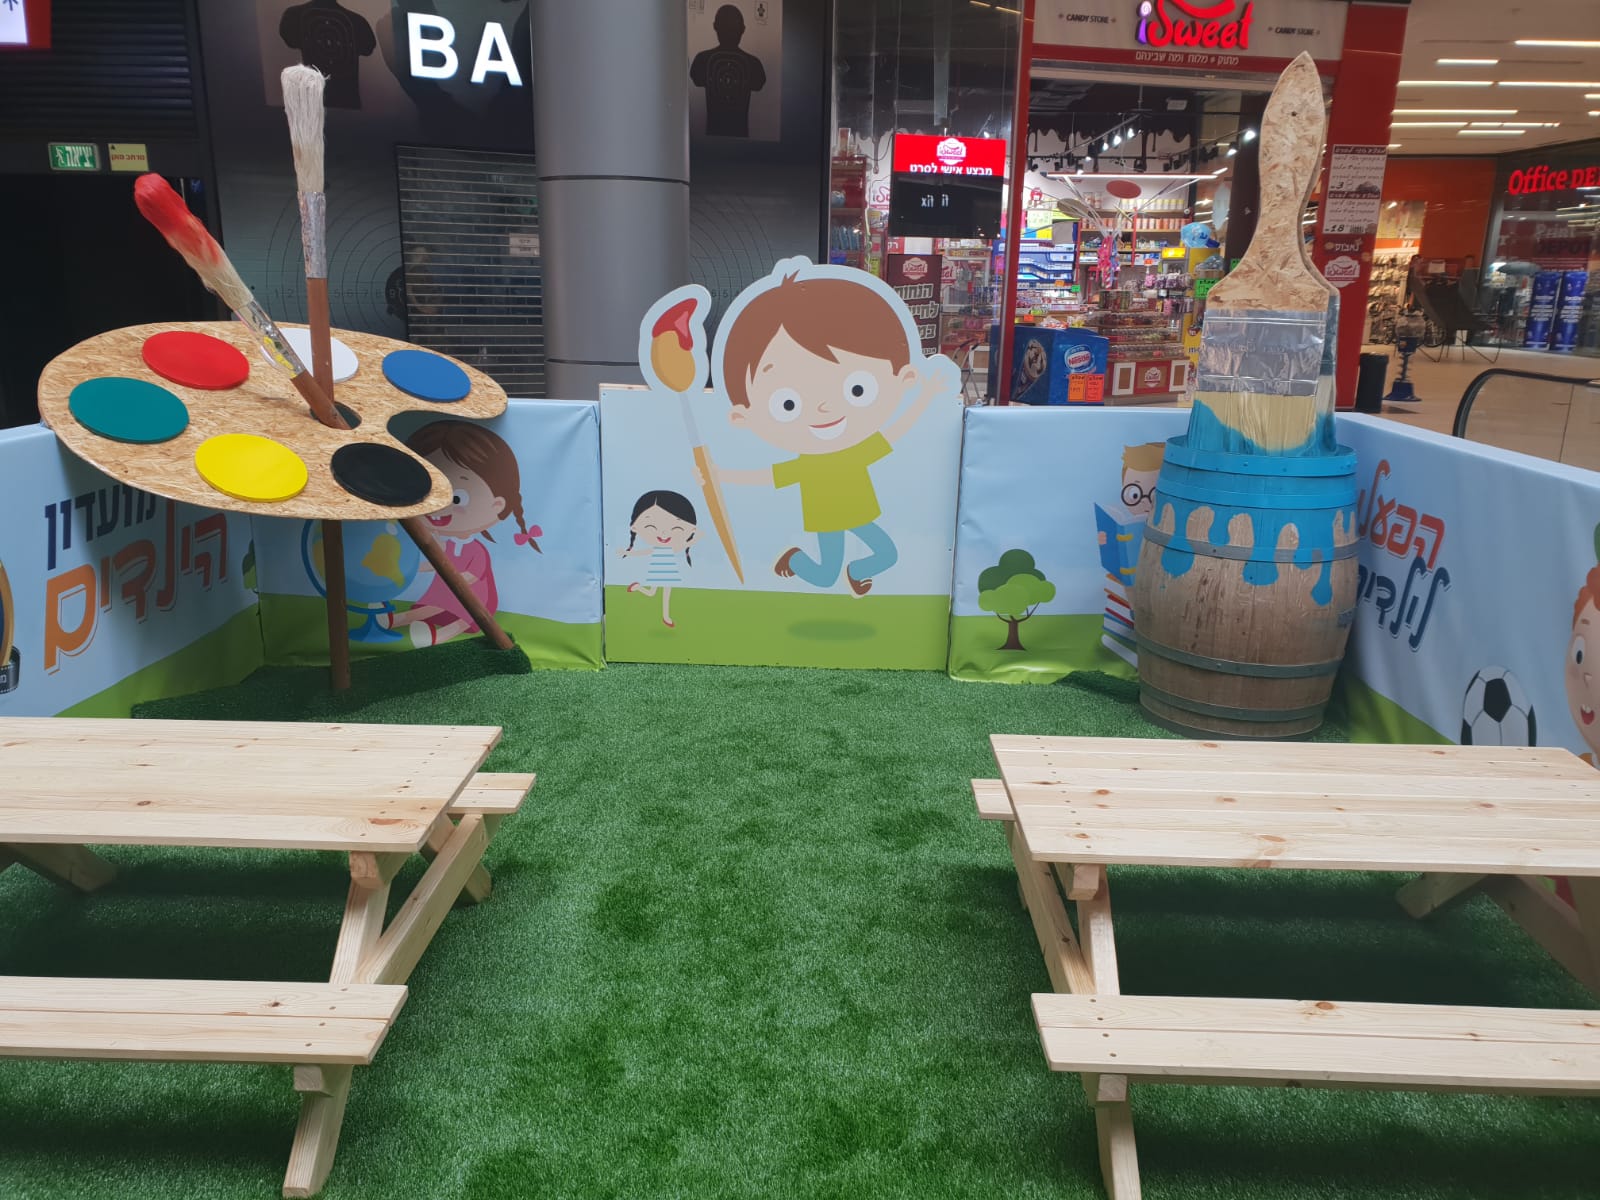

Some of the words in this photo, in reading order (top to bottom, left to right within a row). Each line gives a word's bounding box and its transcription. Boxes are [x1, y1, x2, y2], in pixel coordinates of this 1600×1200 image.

[1066, 13, 1089, 22] CANDY
[1089, 15, 1109, 24] STORE
[1136, 0, 1255, 50] iSweet
[1508, 164, 1568, 195] Office
[1570, 165, 1600, 189] DE
